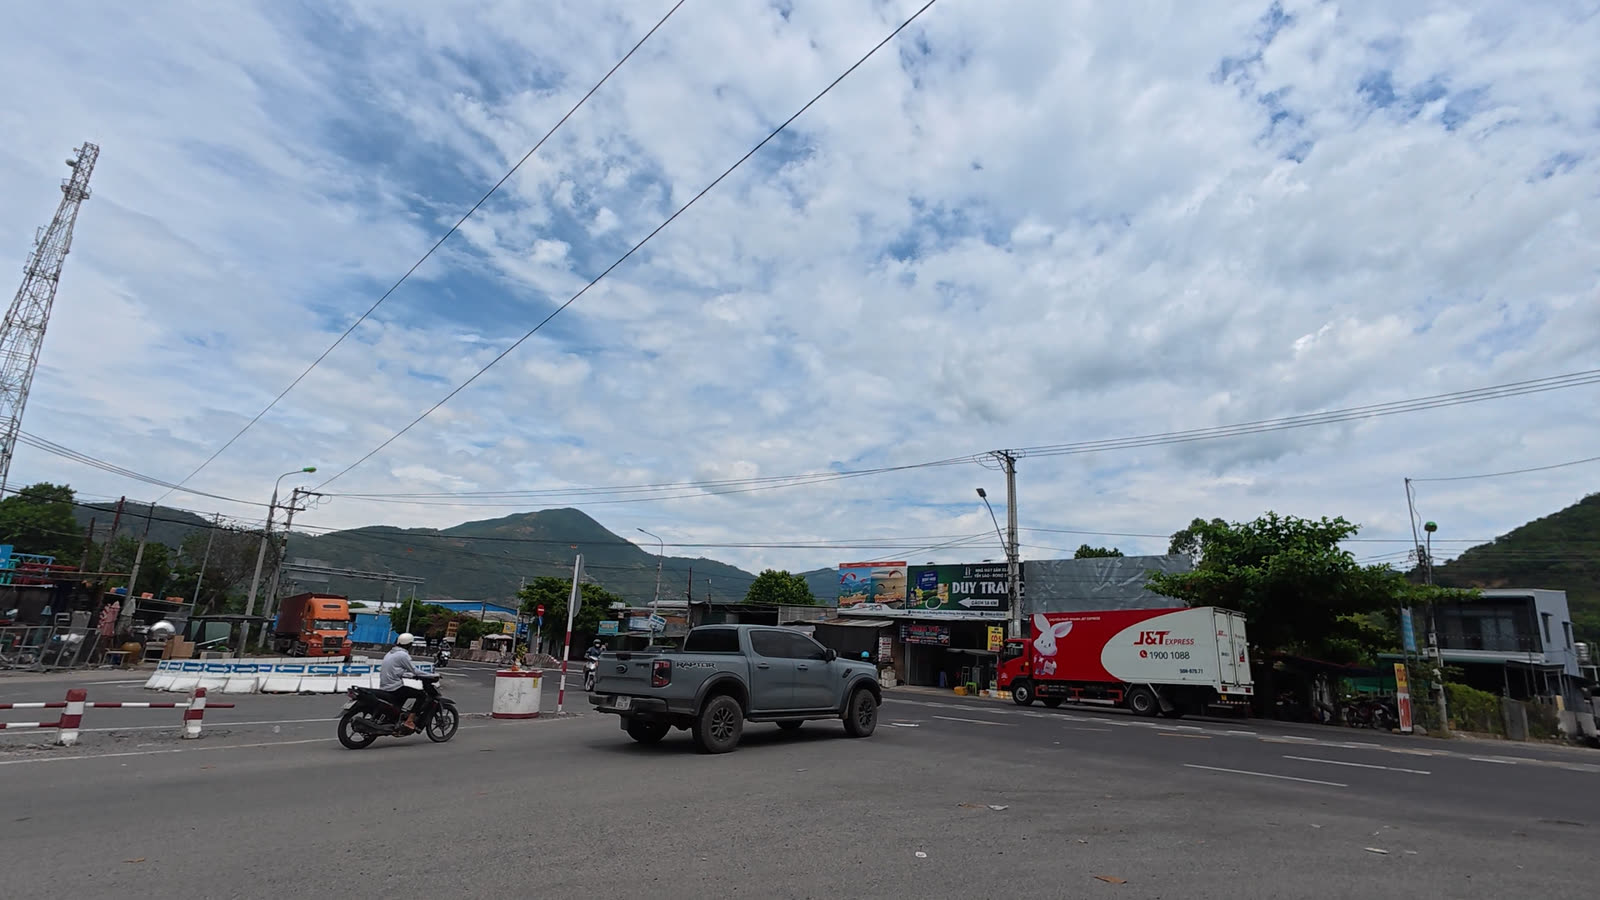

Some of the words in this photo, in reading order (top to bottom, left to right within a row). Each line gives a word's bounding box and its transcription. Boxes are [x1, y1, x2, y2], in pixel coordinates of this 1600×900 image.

[952, 581, 976, 594] DUY
[1133, 631, 1171, 645] J&T
[1149, 651, 1168, 659] 1900
[1170, 651, 1190, 659] 1088
[676, 661, 718, 670] RAPTOR
